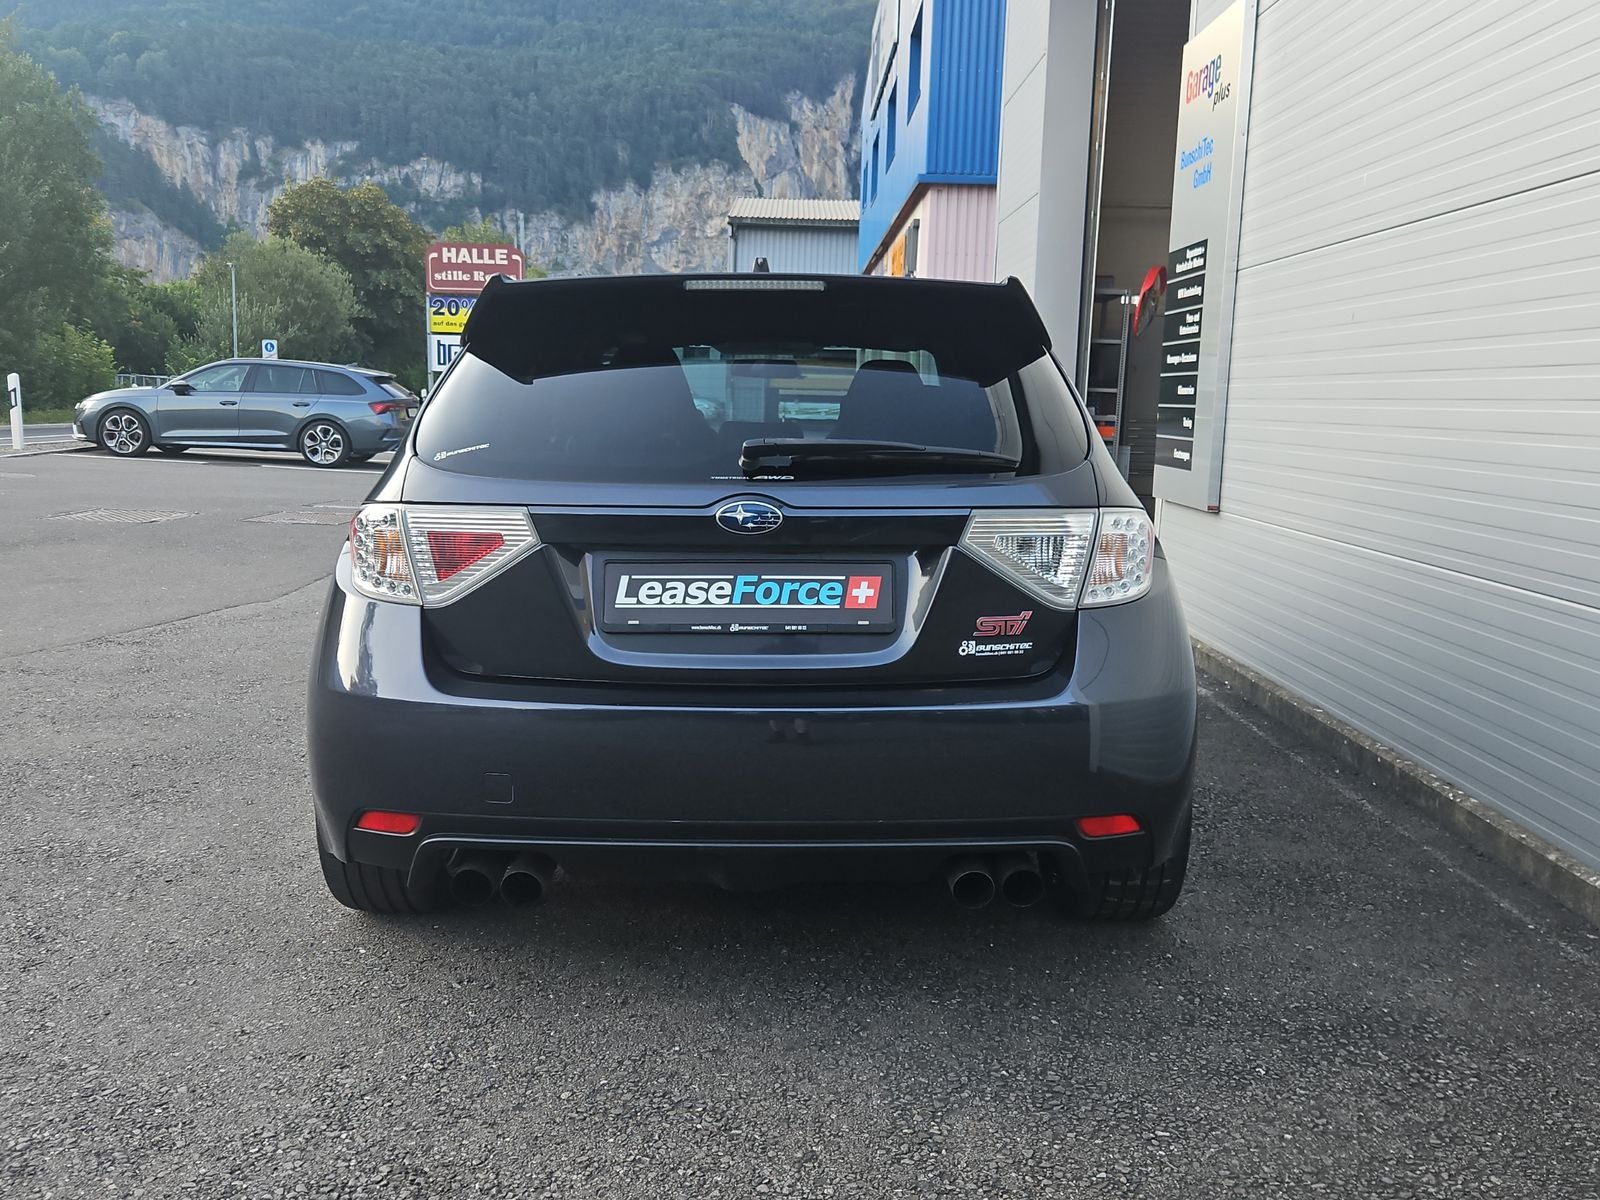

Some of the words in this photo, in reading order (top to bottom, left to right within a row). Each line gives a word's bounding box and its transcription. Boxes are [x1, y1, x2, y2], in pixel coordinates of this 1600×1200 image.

[1186, 54, 1222, 104] Garage
[1212, 82, 1231, 112] plus
[1193, 161, 1212, 188] GmbH
[442, 247, 508, 265] HALLE
[433, 270, 471, 281] stille
[615, 575, 842, 605] LeaseForce
